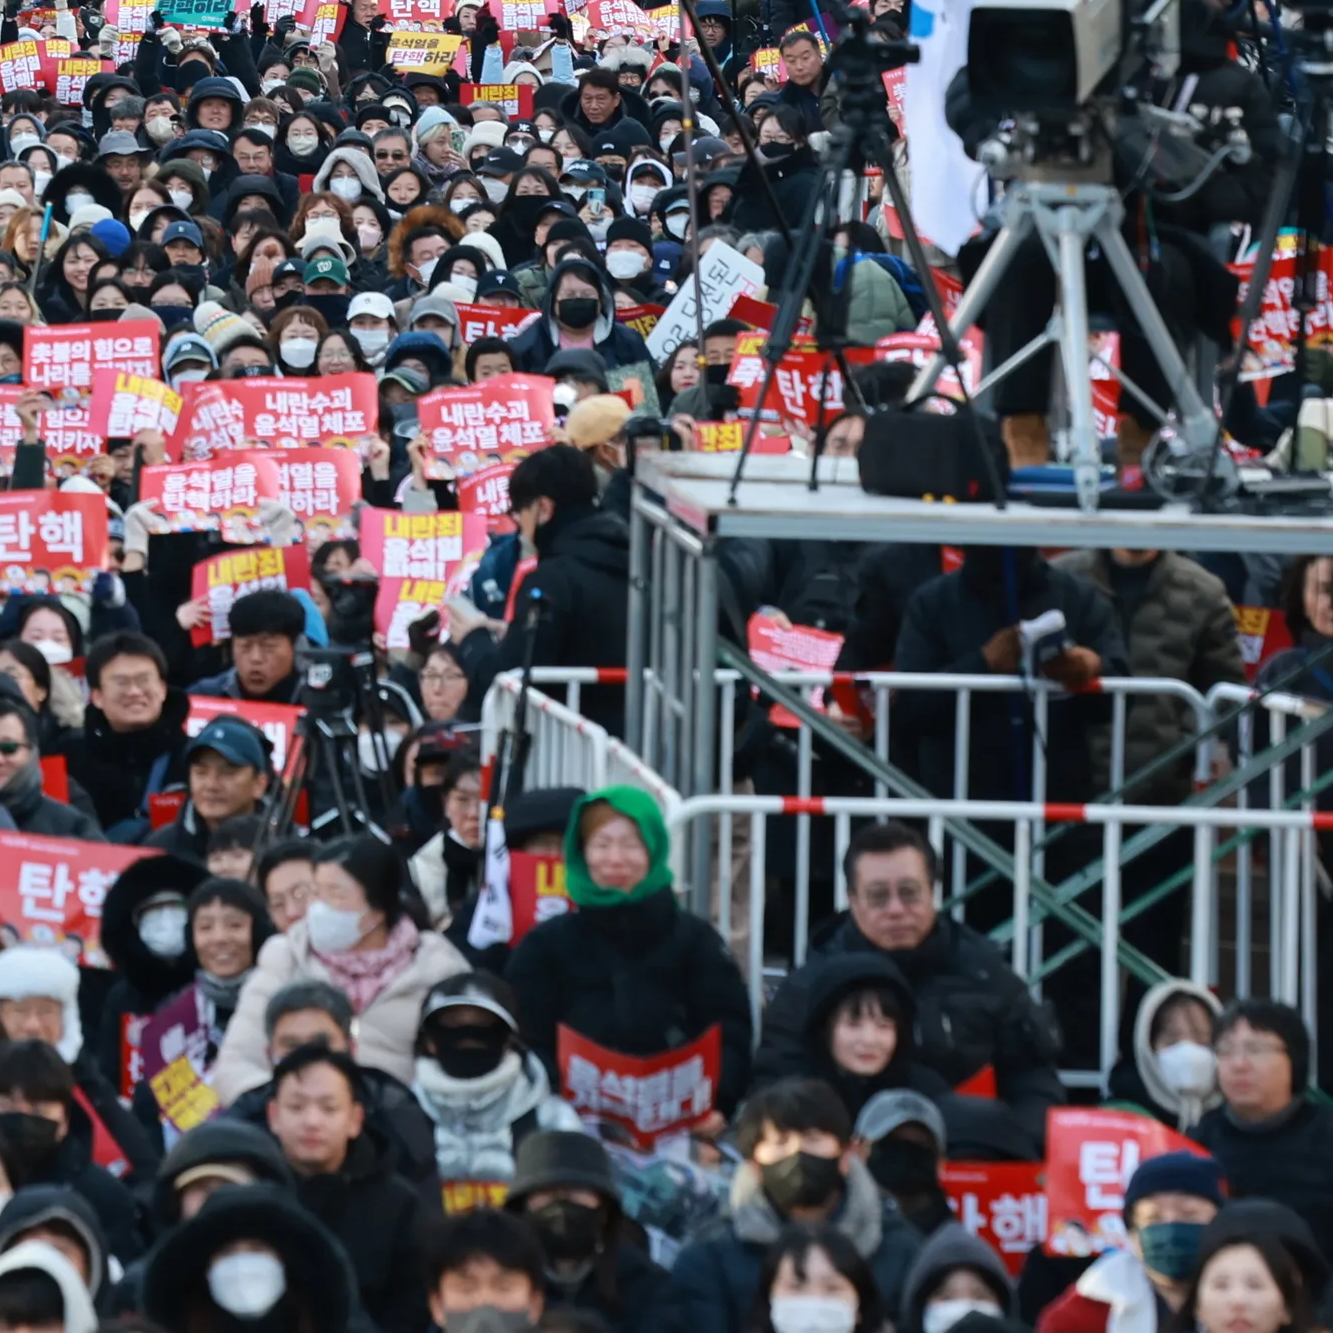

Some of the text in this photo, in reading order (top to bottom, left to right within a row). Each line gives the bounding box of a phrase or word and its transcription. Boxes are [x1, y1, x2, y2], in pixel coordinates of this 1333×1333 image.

[0, 57, 41, 76] 윤석열
[58, 61, 102, 75] 내란죄
[1, 75, 37, 92] 탄핵!
[30, 337, 154, 366] 촛불의 힘으로
[265, 389, 352, 412] 내란수괴
[441, 401, 529, 424] 내란수괴
[162, 465, 254, 492] 윤석열을
